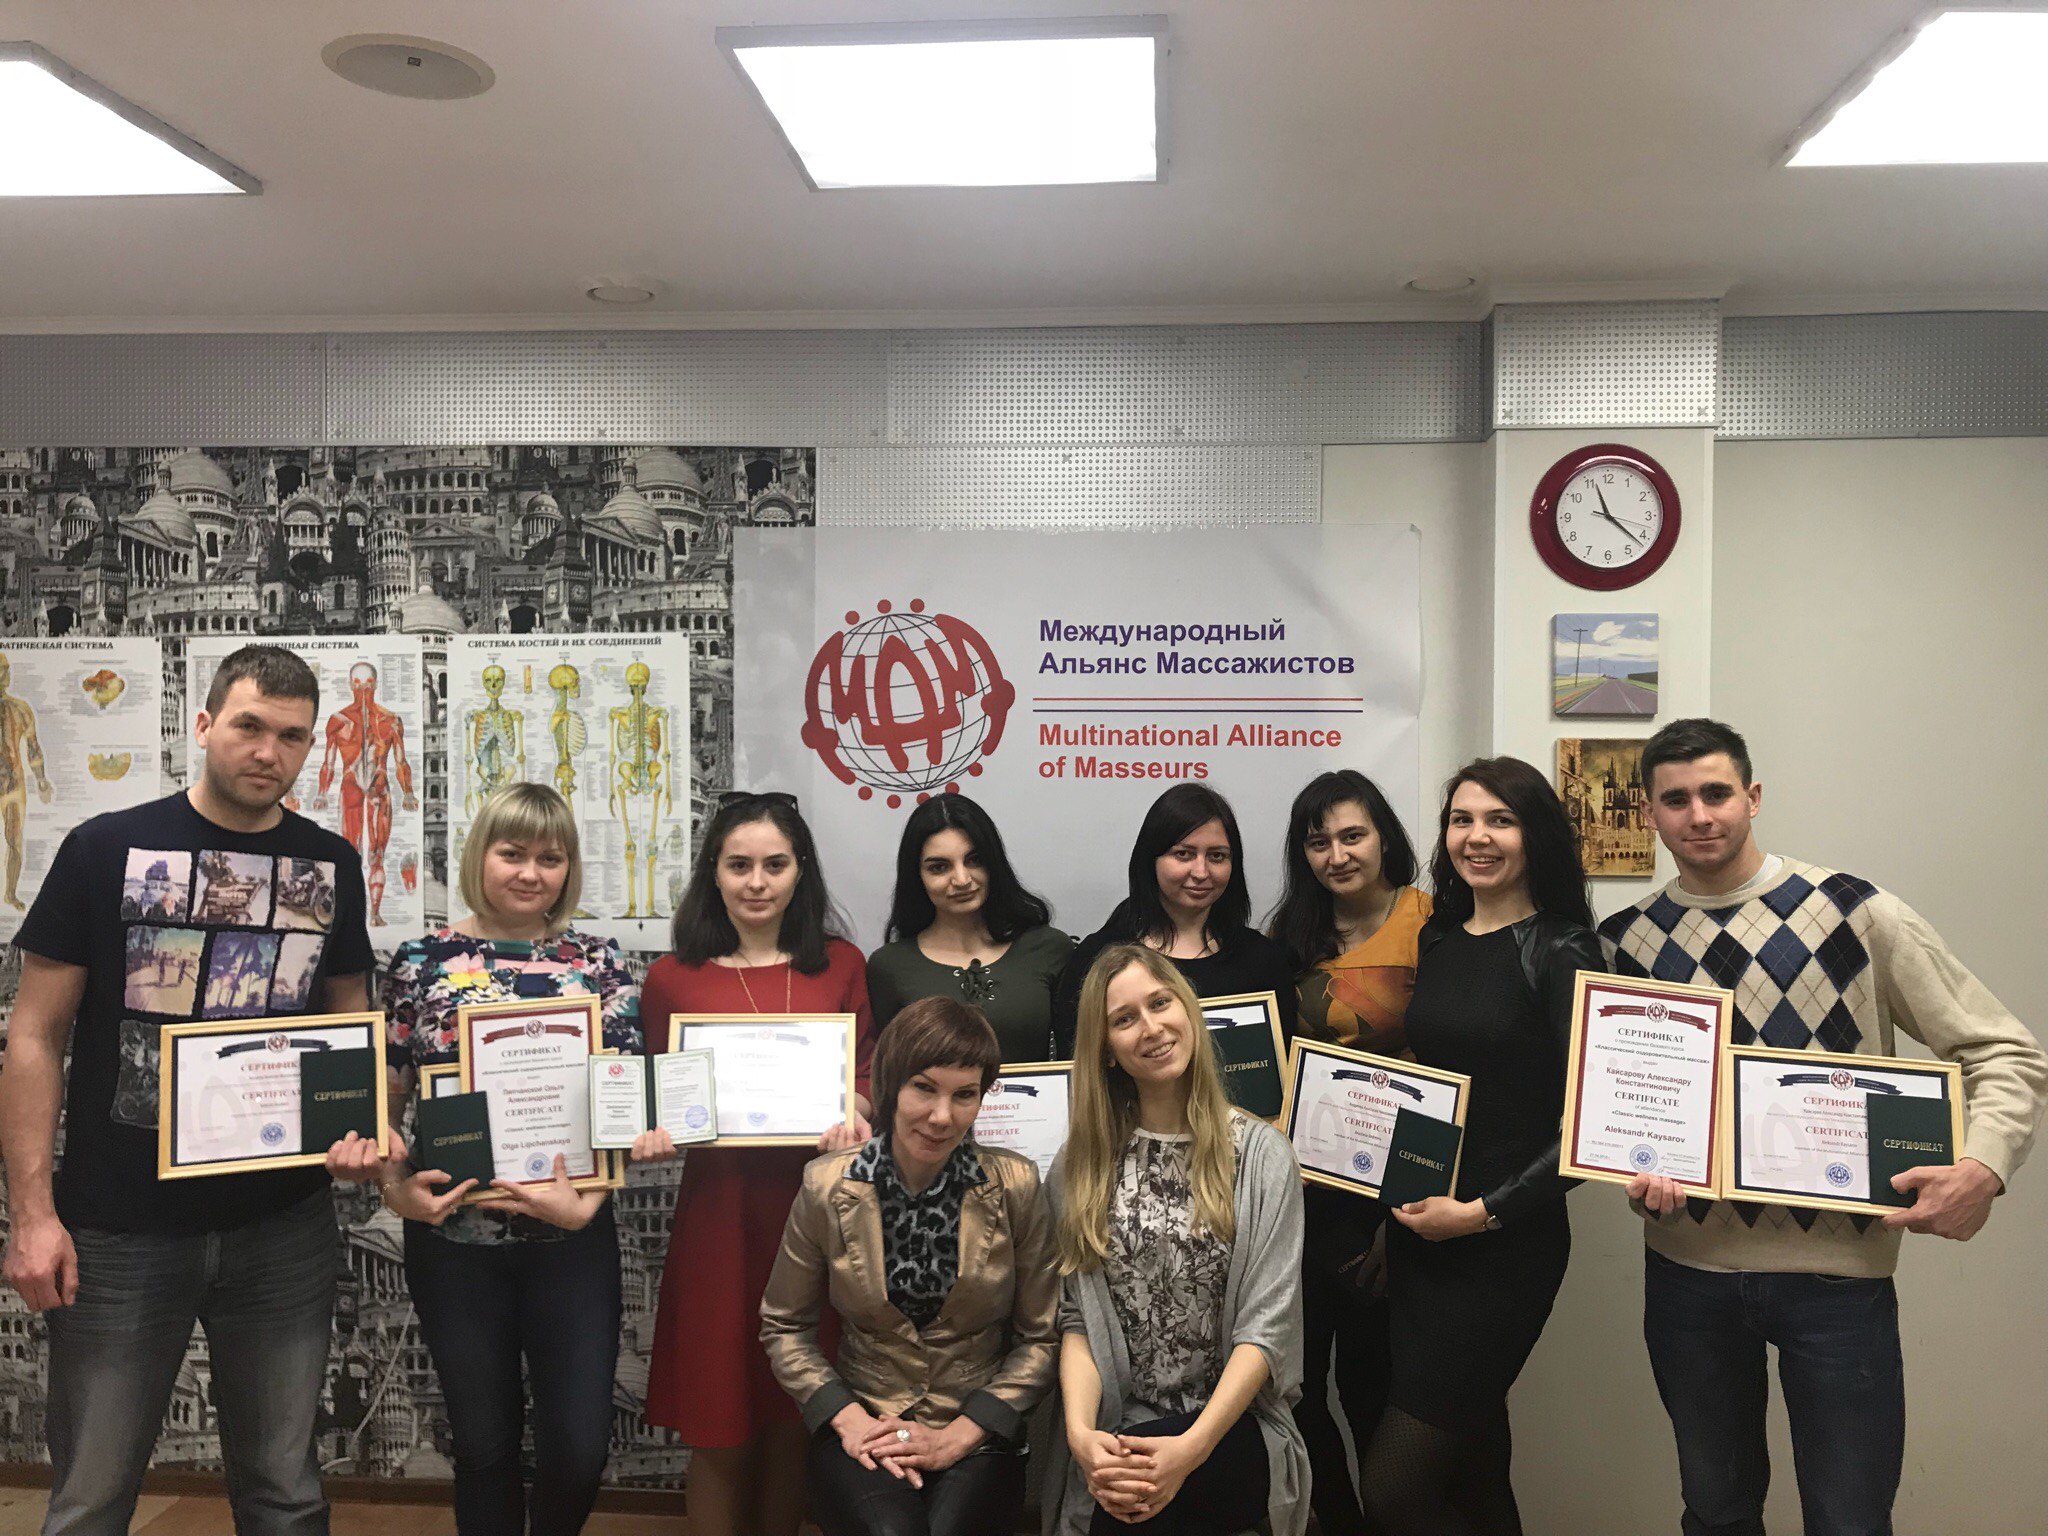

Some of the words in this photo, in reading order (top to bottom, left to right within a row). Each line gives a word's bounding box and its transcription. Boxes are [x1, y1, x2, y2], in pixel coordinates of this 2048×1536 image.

[1584, 478, 1595, 489] 11
[1602, 474, 1614, 484] 12
[1624, 478, 1630, 488] 1
[1570, 492, 1582, 503] 10
[1639, 492, 1646, 502] 2
[1564, 512, 1572, 523] 9
[1645, 511, 1652, 521] 3
[1570, 531, 1577, 541] 8
[1639, 530, 1646, 540] 4
[1586, 546, 1592, 556] 7
[1604, 550, 1612, 560] 6
[1624, 545, 1632, 555] 5
[1039, 618, 1286, 646] Международный
[64, 642, 113, 650] СИСТЕМА
[311, 642, 359, 650] СИСТЕМА
[468, 640, 516, 648] СИСТЕМА
[518, 638, 559, 648] КОСТЕЙ
[588, 636, 662, 646] СОЕДИНЕНИЙ
[1039, 652, 1147, 674] Альянс
[1157, 652, 1355, 674] Массажистов
[1039, 723, 1218, 747] Multinational
[1226, 723, 1341, 747] Alliance
[1038, 757, 1066, 779] of
[1074, 757, 1208, 779] Masseurs
[1618, 1028, 1685, 1044] СЕРТИФИКАТ
[240, 1061, 298, 1071] СЕРТИФИК
[1224, 1060, 1268, 1072] СЕРТИФИКАТ
[1614, 1090, 1680, 1107] CERTIFICATE
[1803, 1096, 1868, 1110] СЕРТИФИК
[980, 1103, 1020, 1112] ТИФИКАТ
[1344, 1116, 1392, 1134] CERTIFICAT
[974, 1128, 1020, 1136] ERTIFICATE
[1605, 1125, 1645, 1137] Aleksandr
[1648, 1132, 1686, 1143] Kaysarov
[1805, 1126, 1868, 1140] CERTIFICAT
[1883, 1138, 1944, 1152] СЕРТИФИКАТ
[1398, 1150, 1446, 1171] СЕРТИФИКАТ
